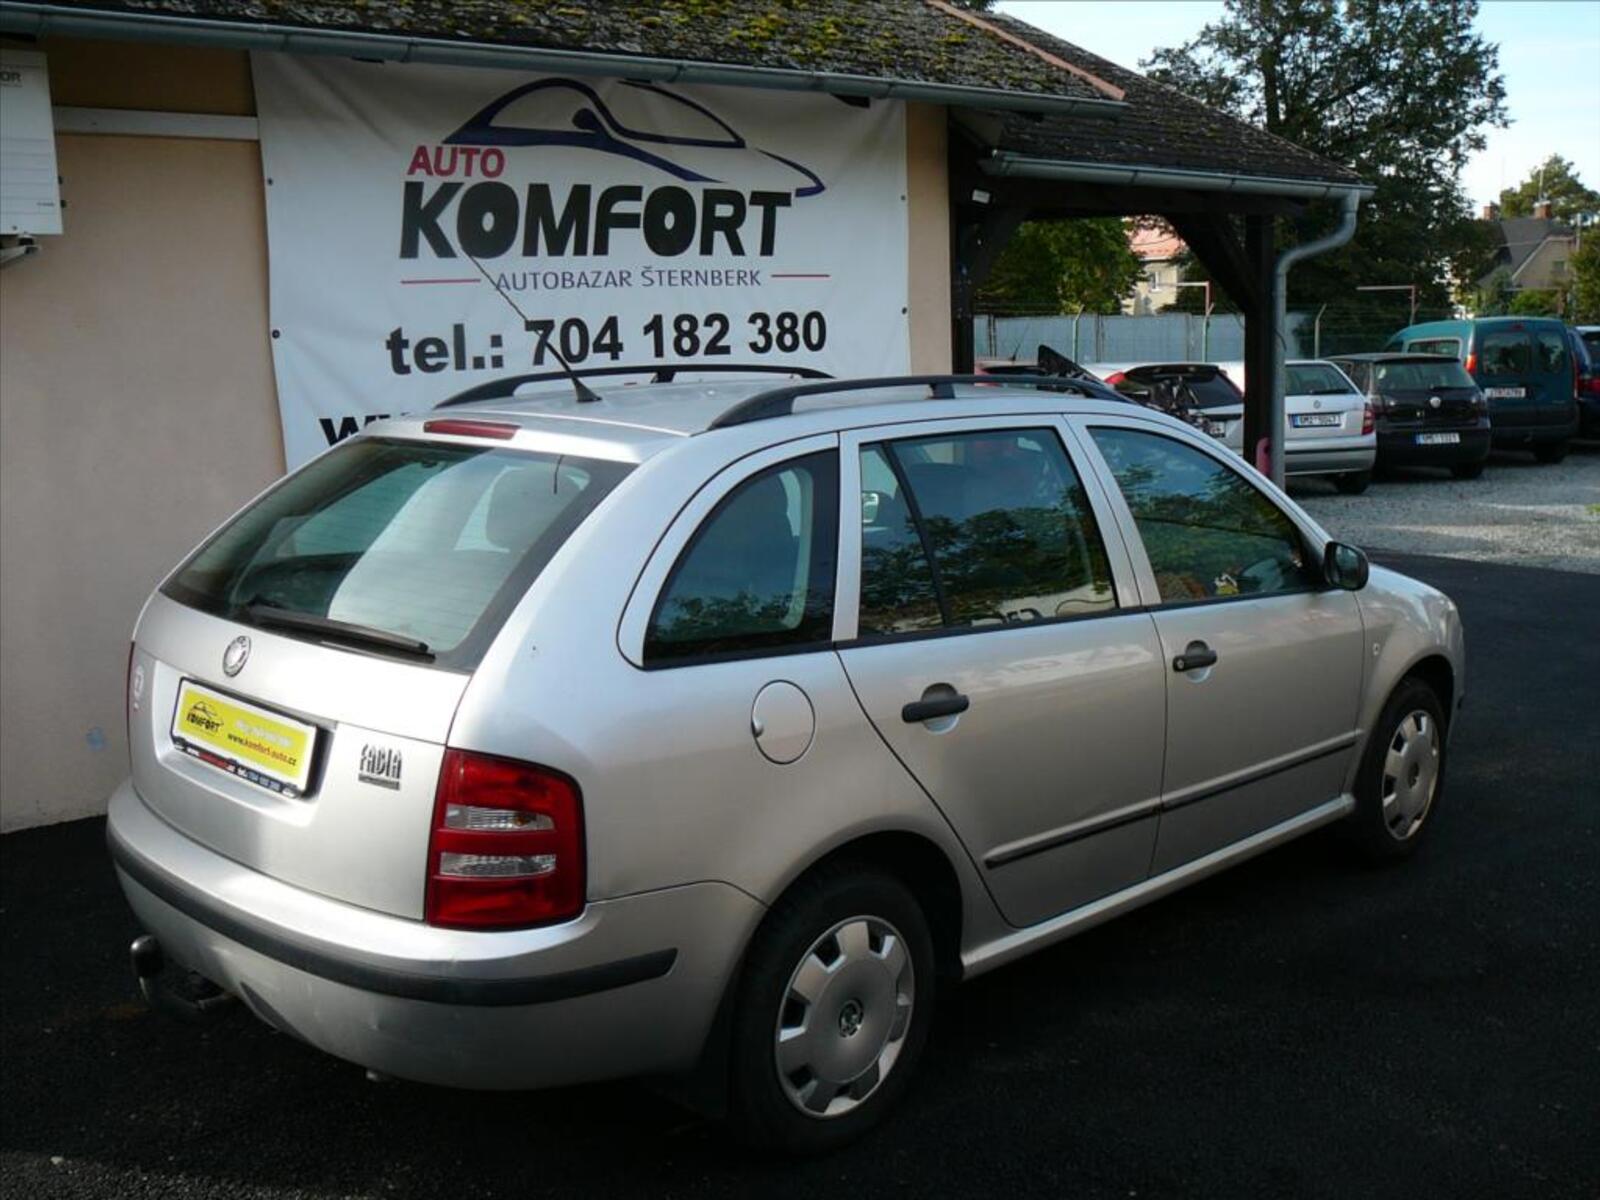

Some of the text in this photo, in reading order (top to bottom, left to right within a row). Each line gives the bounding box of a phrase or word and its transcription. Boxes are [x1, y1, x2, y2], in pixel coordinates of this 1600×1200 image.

[407, 146, 505, 178] AUTO
[400, 181, 792, 259] KOMFORT
[496, 266, 762, 291] AUTOBAZAR ŠTERNBERK
[386, 310, 827, 375] tel.: 704 182 380
